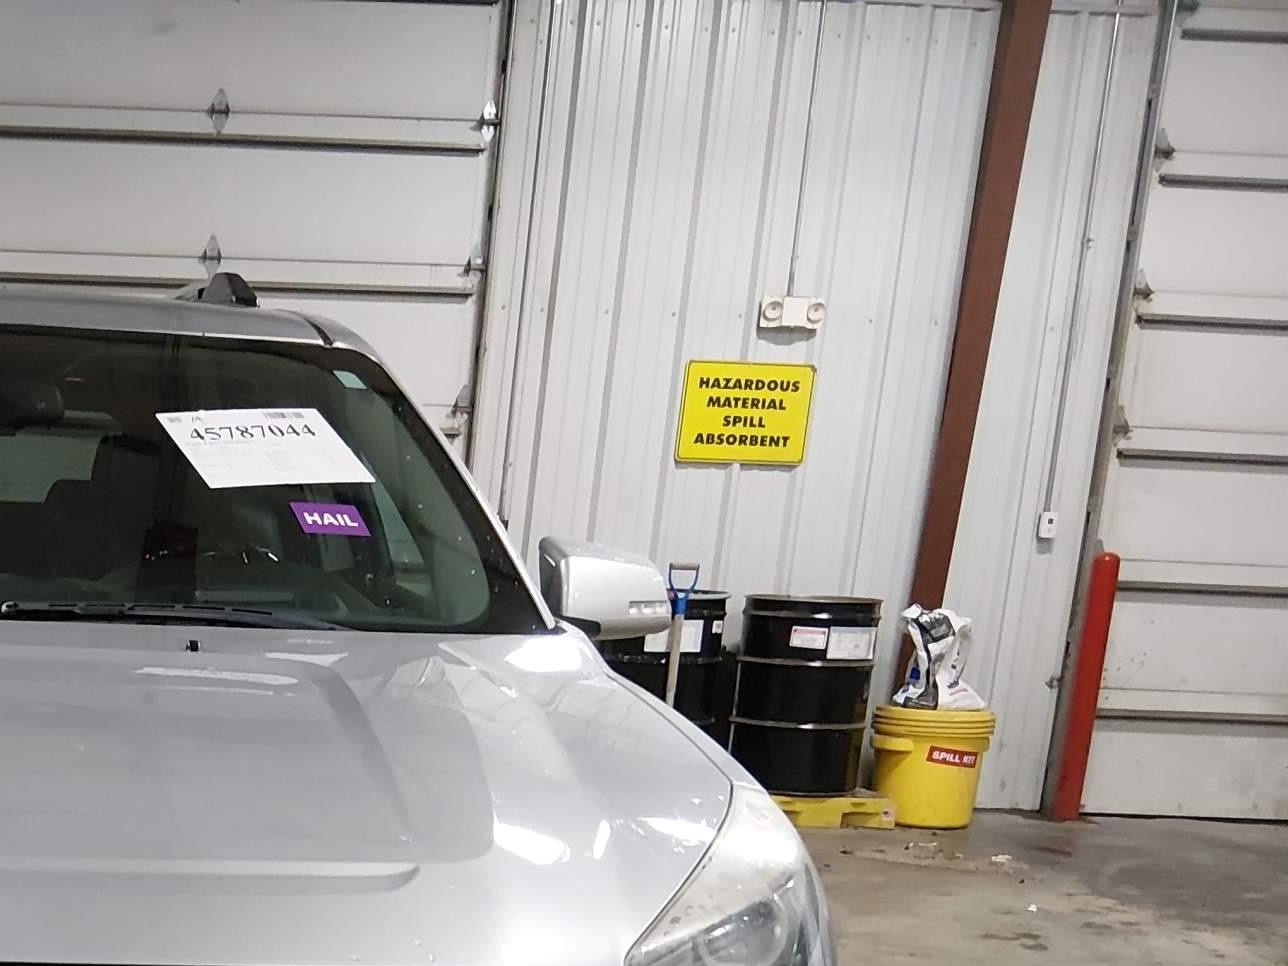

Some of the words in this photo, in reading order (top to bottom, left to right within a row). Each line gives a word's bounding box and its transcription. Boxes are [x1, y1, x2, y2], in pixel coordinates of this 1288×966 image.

[699, 377, 800, 392] HAZARDOUS
[707, 396, 786, 410] MATERIAL
[722, 415, 765, 428] SPILL
[190, 424, 316, 441] 45787044
[694, 433, 790, 447] ABSORBENT
[303, 512, 359, 527] HAIL
[932, 751, 960, 763] SPILL
